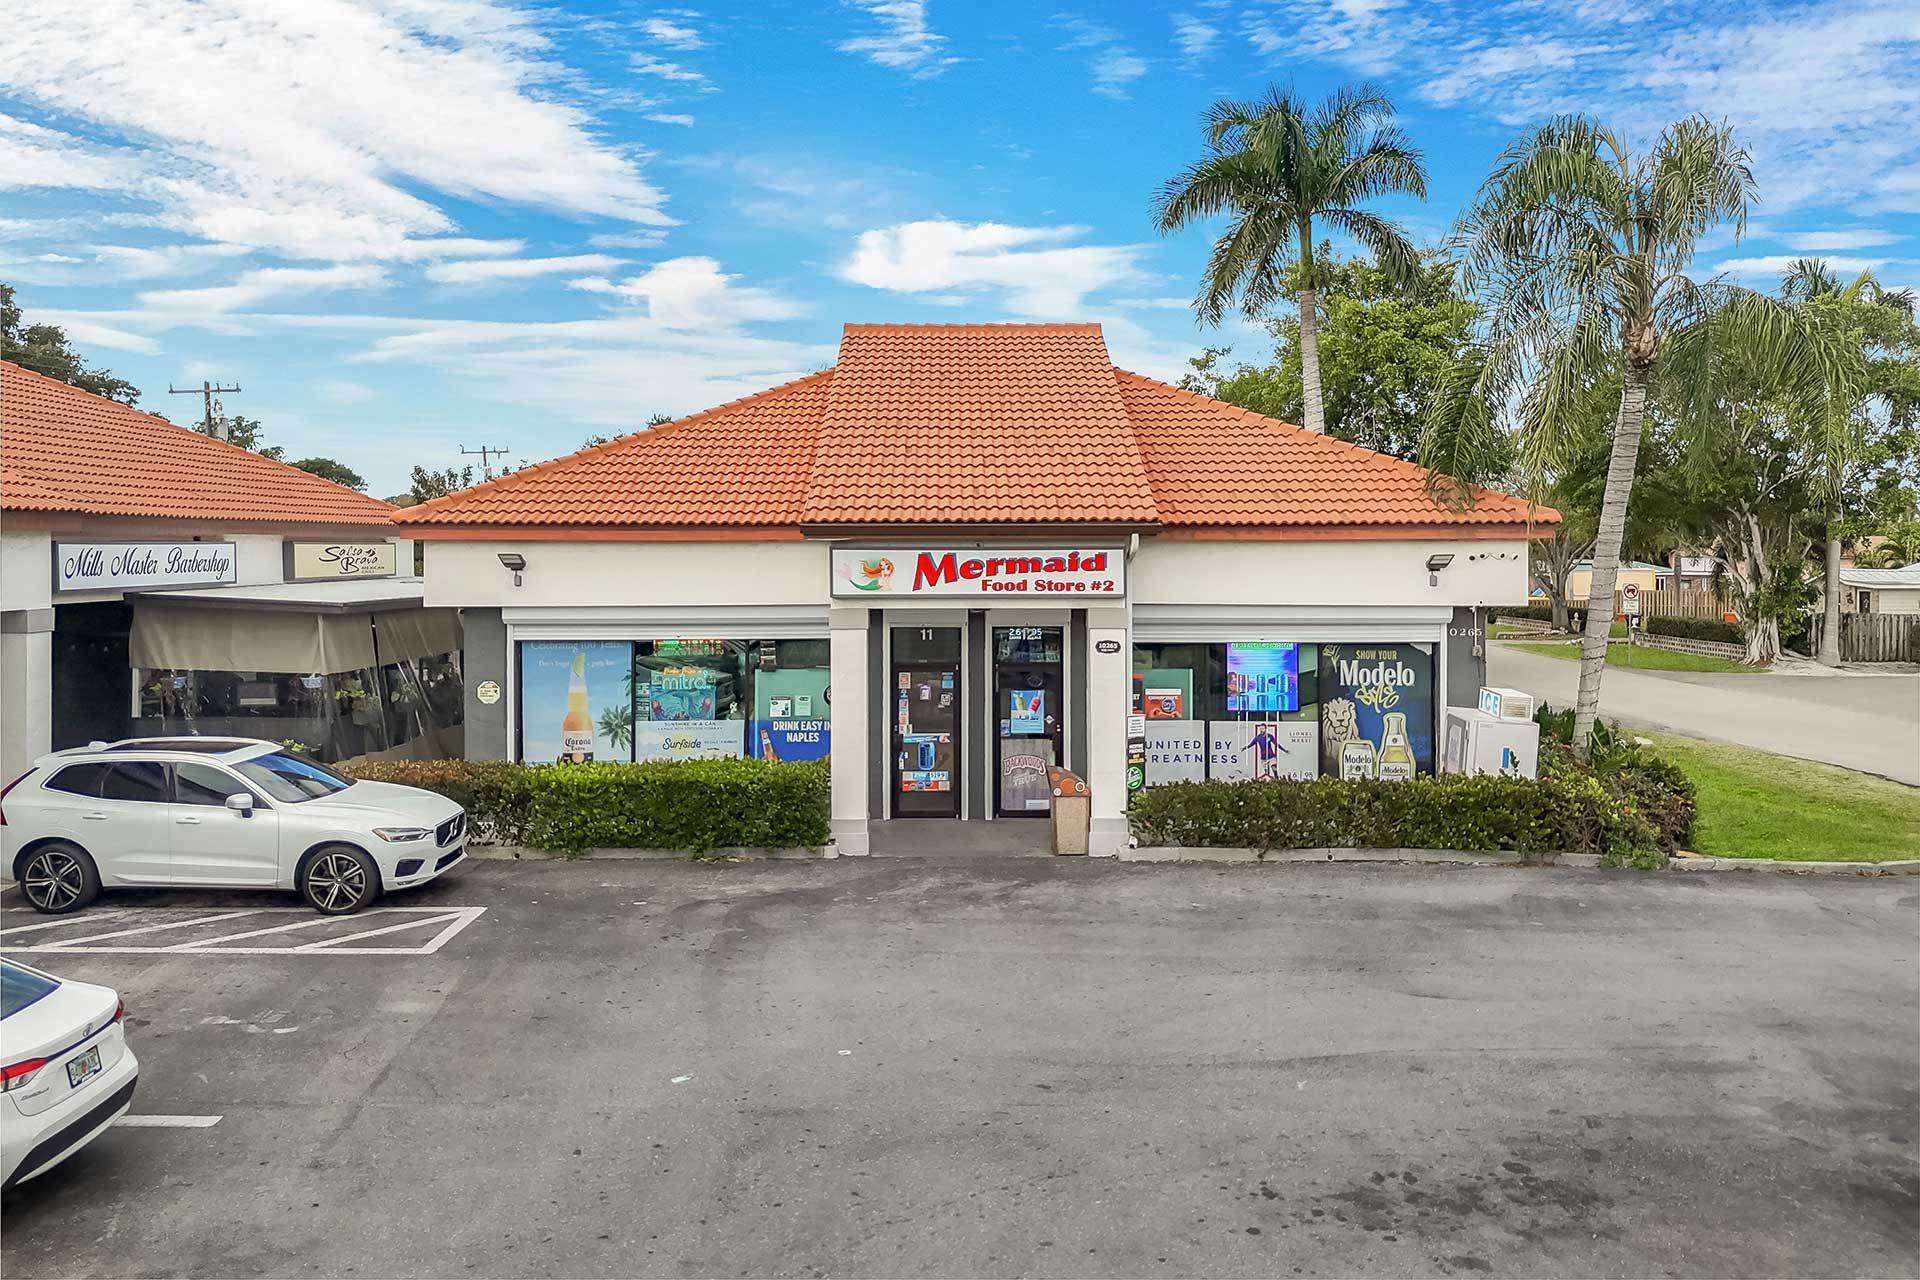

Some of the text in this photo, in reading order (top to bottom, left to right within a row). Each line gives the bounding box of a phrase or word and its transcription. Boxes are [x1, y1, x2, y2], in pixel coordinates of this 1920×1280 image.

[318, 545, 362, 562] Salsa
[64, 546, 230, 580] Mills Master Barbershop
[339, 556, 378, 574] Brava
[912, 551, 1108, 592] Mermaid
[981, 579, 1114, 592] Food Store #2
[919, 628, 933, 641] 11
[1022, 627, 1035, 640] 12
[1355, 650, 1397, 660] SHOW YOUR
[1340, 659, 1415, 687] Modelo
[1480, 690, 1499, 717] ICE
[773, 721, 799, 731] DRINK
[801, 721, 823, 731] EASY
[564, 737, 592, 747] Corona
[662, 737, 702, 750] Surfside
[786, 732, 820, 743] NAPLES
[1145, 740, 1201, 750] UNITED
[1215, 740, 1232, 750] BY
[1146, 754, 1238, 764] REATNESS
[1344, 754, 1372, 764] Modelo
[1383, 766, 1406, 774] Modelo
